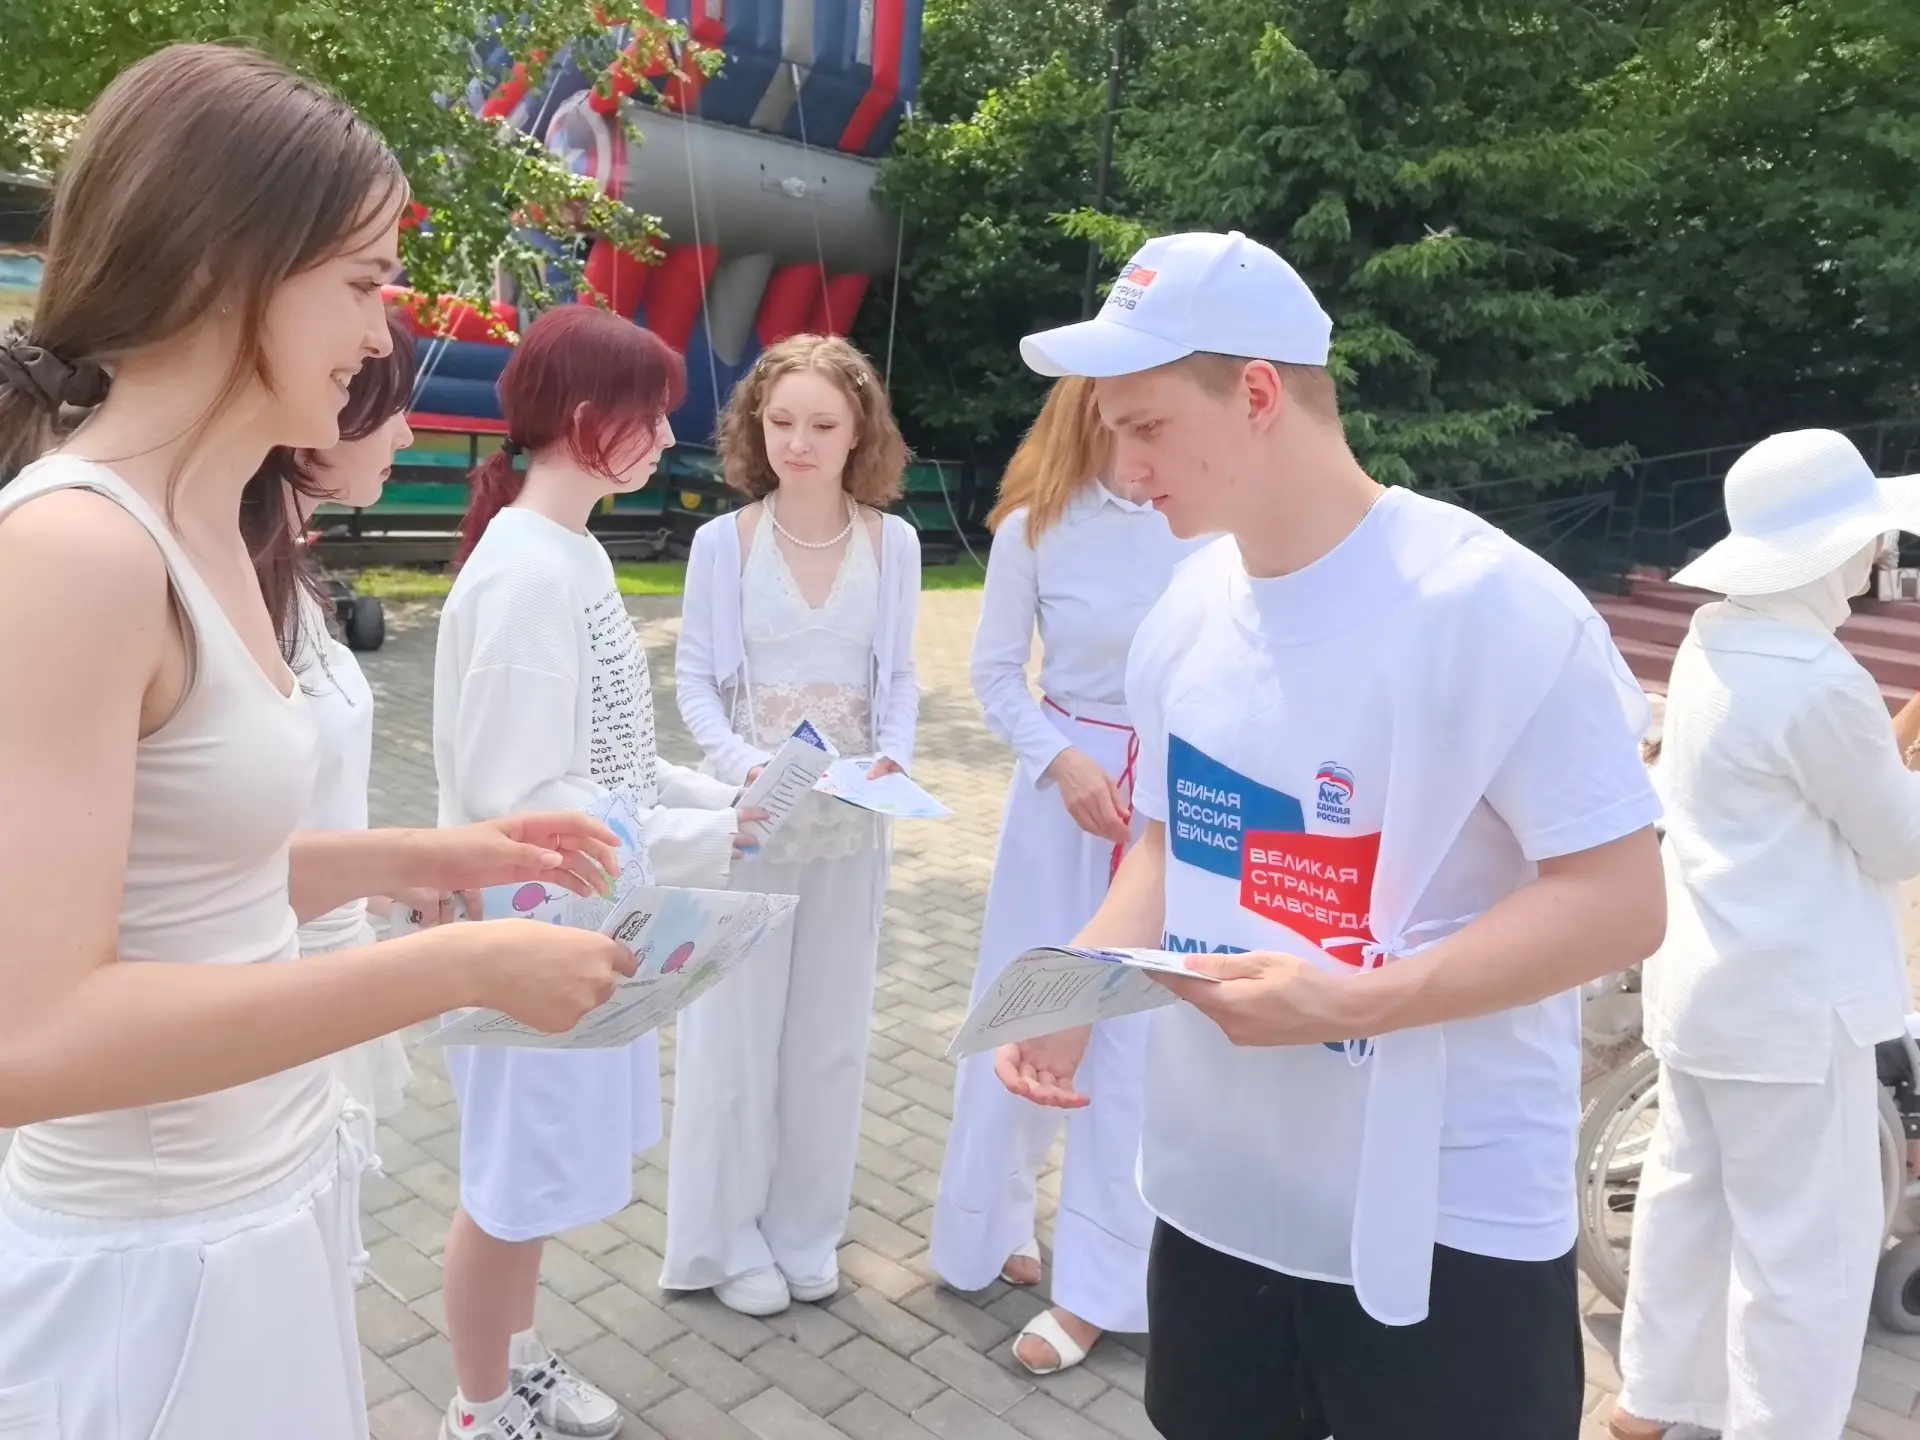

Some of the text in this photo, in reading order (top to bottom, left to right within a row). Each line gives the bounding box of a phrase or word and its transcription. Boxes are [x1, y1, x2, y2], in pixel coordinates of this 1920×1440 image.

[1108, 296, 1137, 310] РОВ
[591, 741, 633, 754] NOT TO
[591, 760, 635, 775] BECAUSE
[1176, 779, 1241, 809] ЕДИНАЯ
[1176, 799, 1241, 831] РОССИЯ
[1316, 802, 1351, 815] ЕДИНАЯ
[1316, 811, 1351, 825] РОССИЯ
[1250, 848, 1359, 884] ВЕЛИКАЯ
[1251, 869, 1341, 905] СТРАНА
